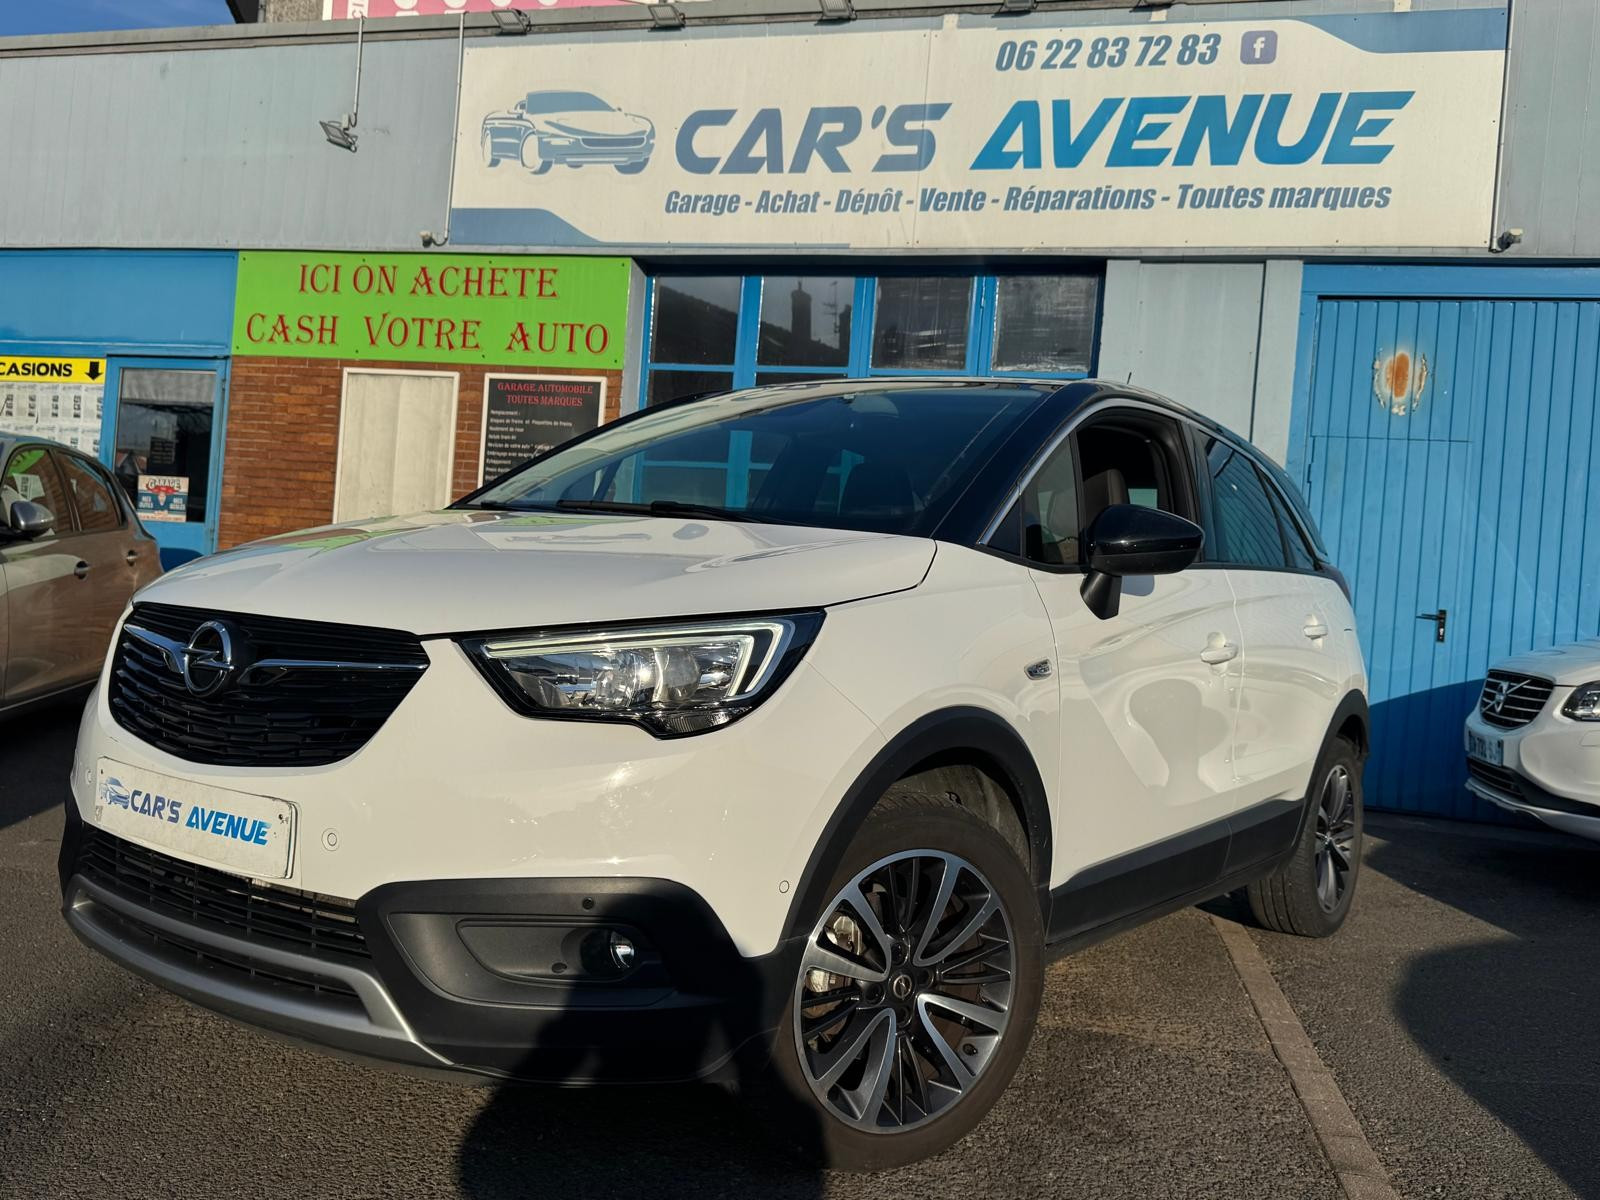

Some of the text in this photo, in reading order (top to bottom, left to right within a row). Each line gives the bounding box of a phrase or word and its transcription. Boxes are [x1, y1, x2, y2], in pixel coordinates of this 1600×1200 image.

[995, 33, 1221, 71] 06 22 83 72 83
[675, 91, 1416, 175] CAR'S AVENUE
[664, 190, 741, 216] Garage
[755, 190, 820, 213] Achat
[835, 188, 903, 215] Dépôt
[919, 188, 987, 212] Vente
[1003, 185, 1157, 213] Réparations
[1177, 184, 1265, 209] Toutes
[1268, 185, 1392, 211] marques
[299, 264, 560, 299] ICI ON ACHETE
[246, 312, 609, 355] CASH VOTRE AUTO
[497, 382, 593, 394] GARAGE AUTOMOBILE
[506, 394, 583, 407] TOUTES MARQUES
[130, 789, 272, 846] CAR'S AVENUE
